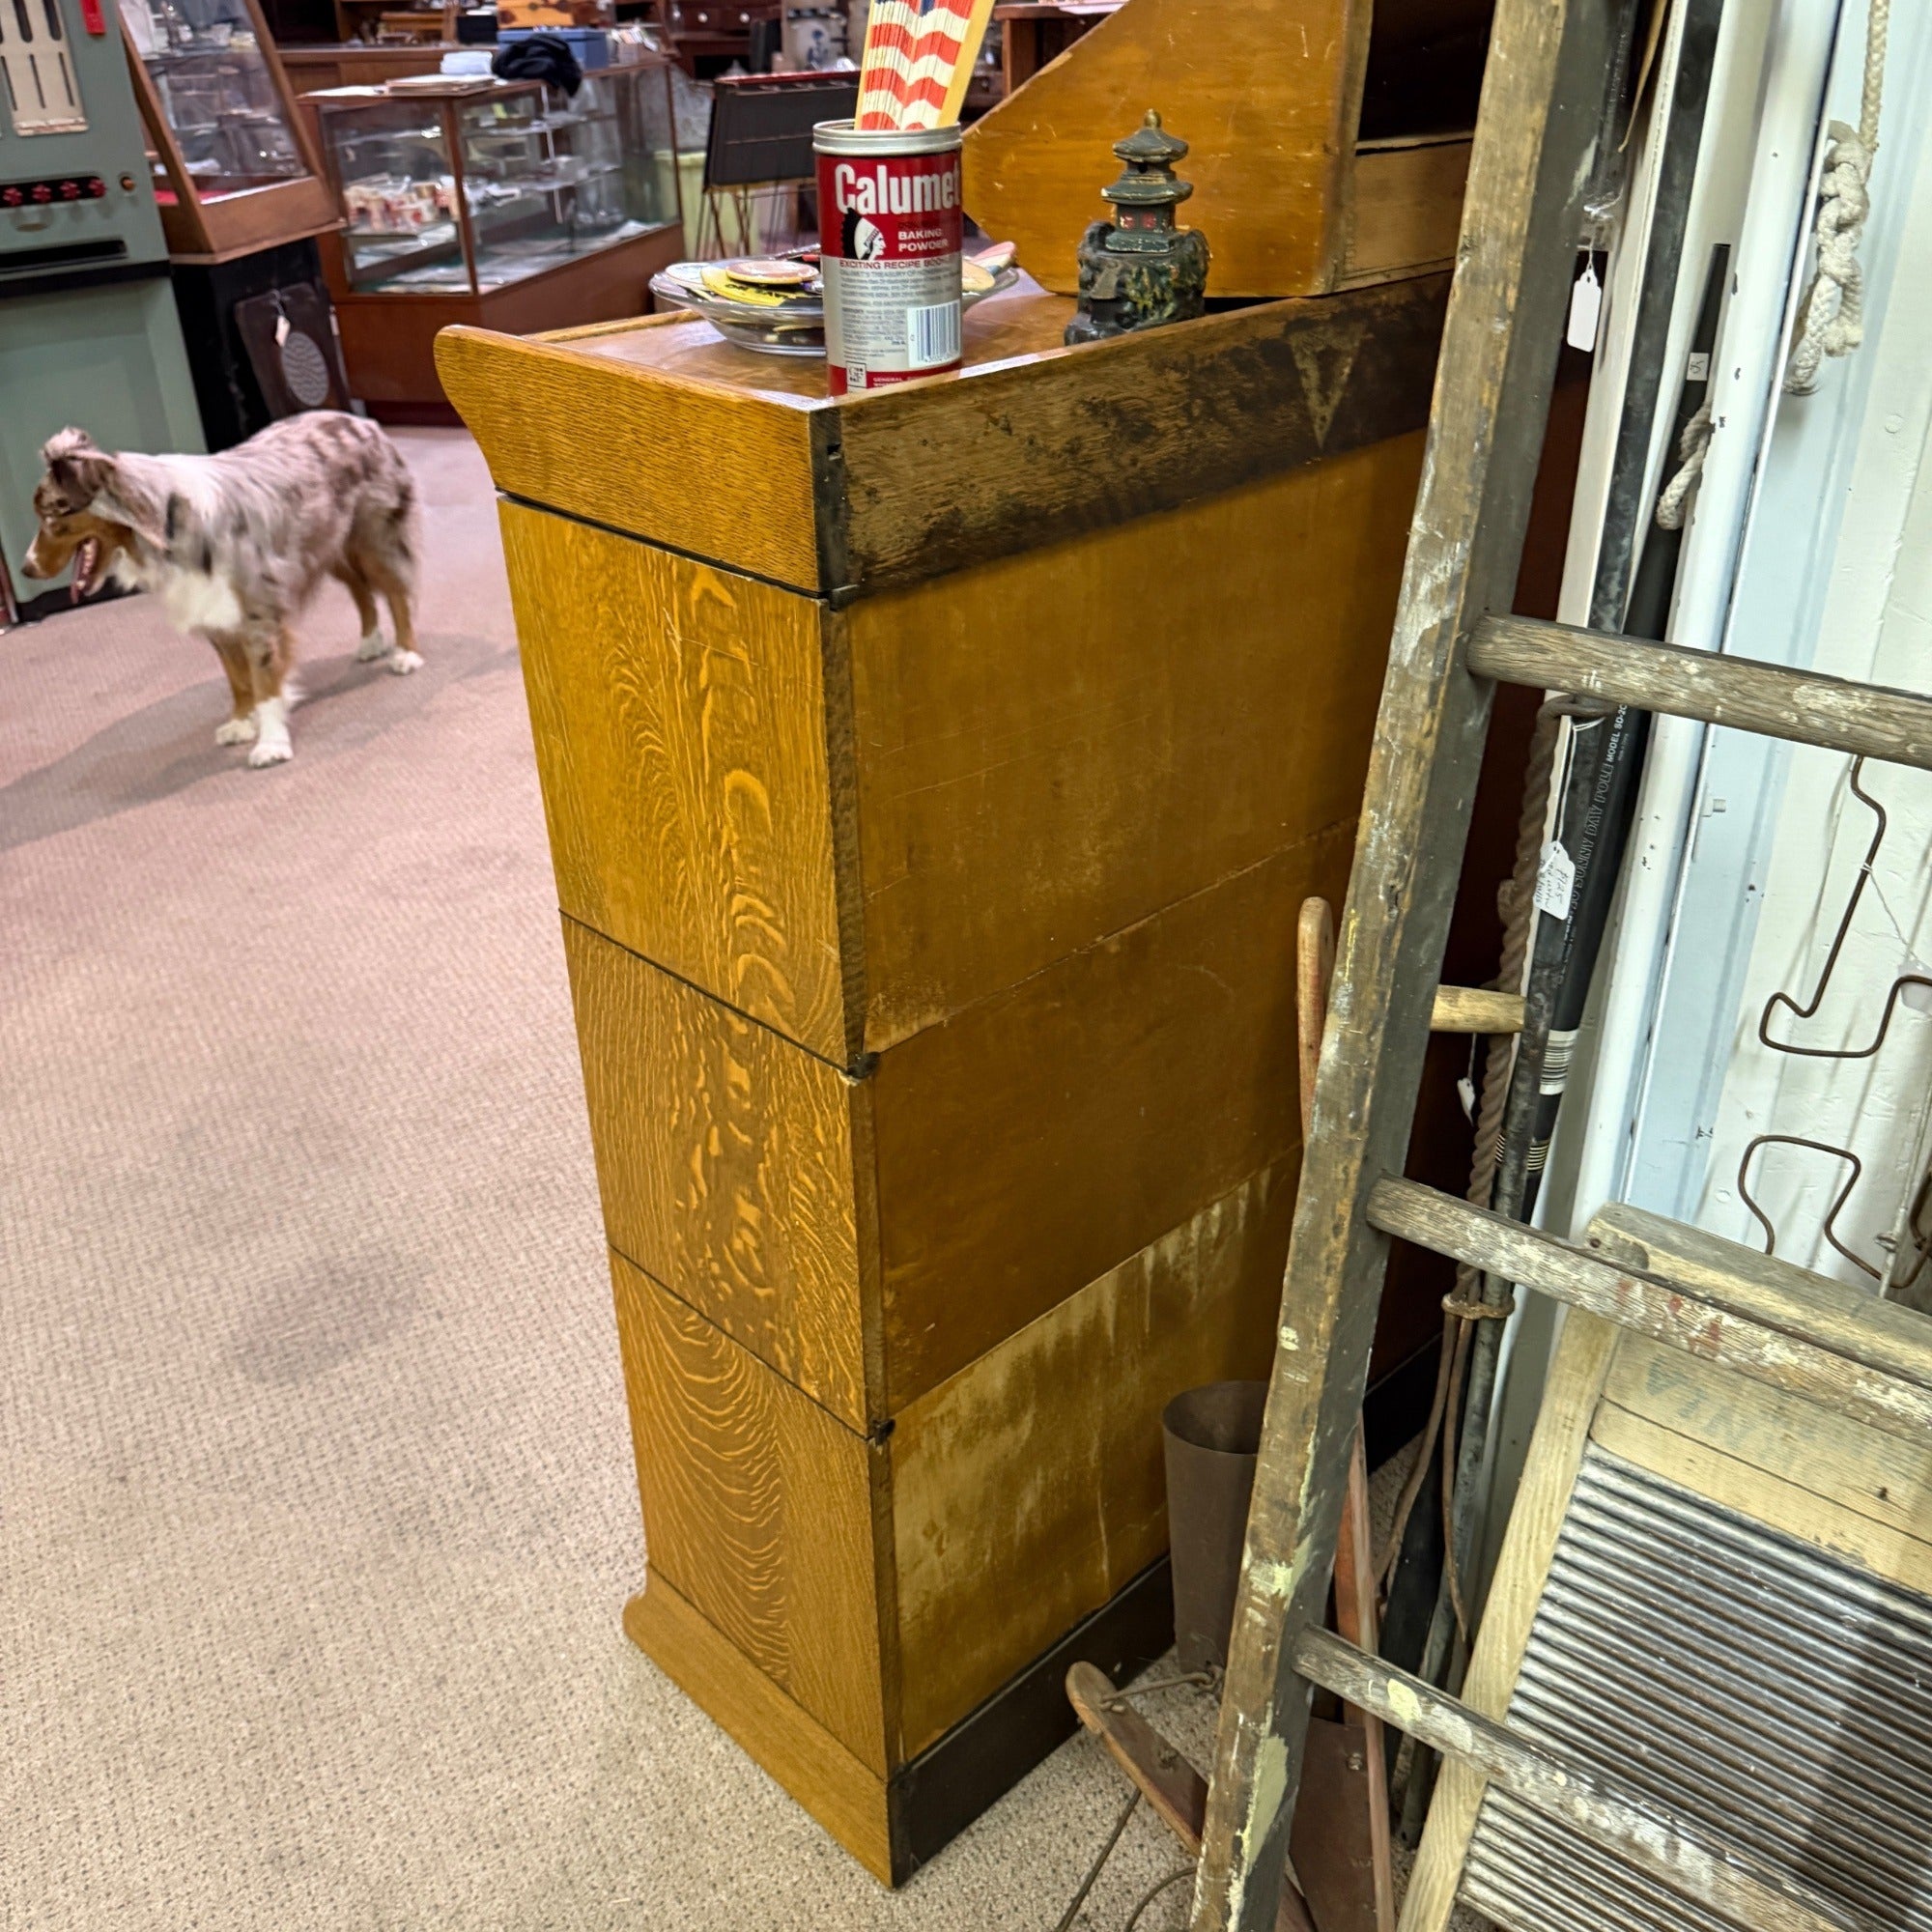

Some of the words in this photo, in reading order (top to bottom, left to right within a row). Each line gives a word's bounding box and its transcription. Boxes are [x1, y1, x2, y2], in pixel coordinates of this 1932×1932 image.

[897, 228, 942, 241] BAKING
[898, 239, 949, 251] POWDER
[839, 259, 881, 270] EXCITING
[884, 260, 921, 270] RECIPE
[1605, 732, 1621, 763] MODEL
